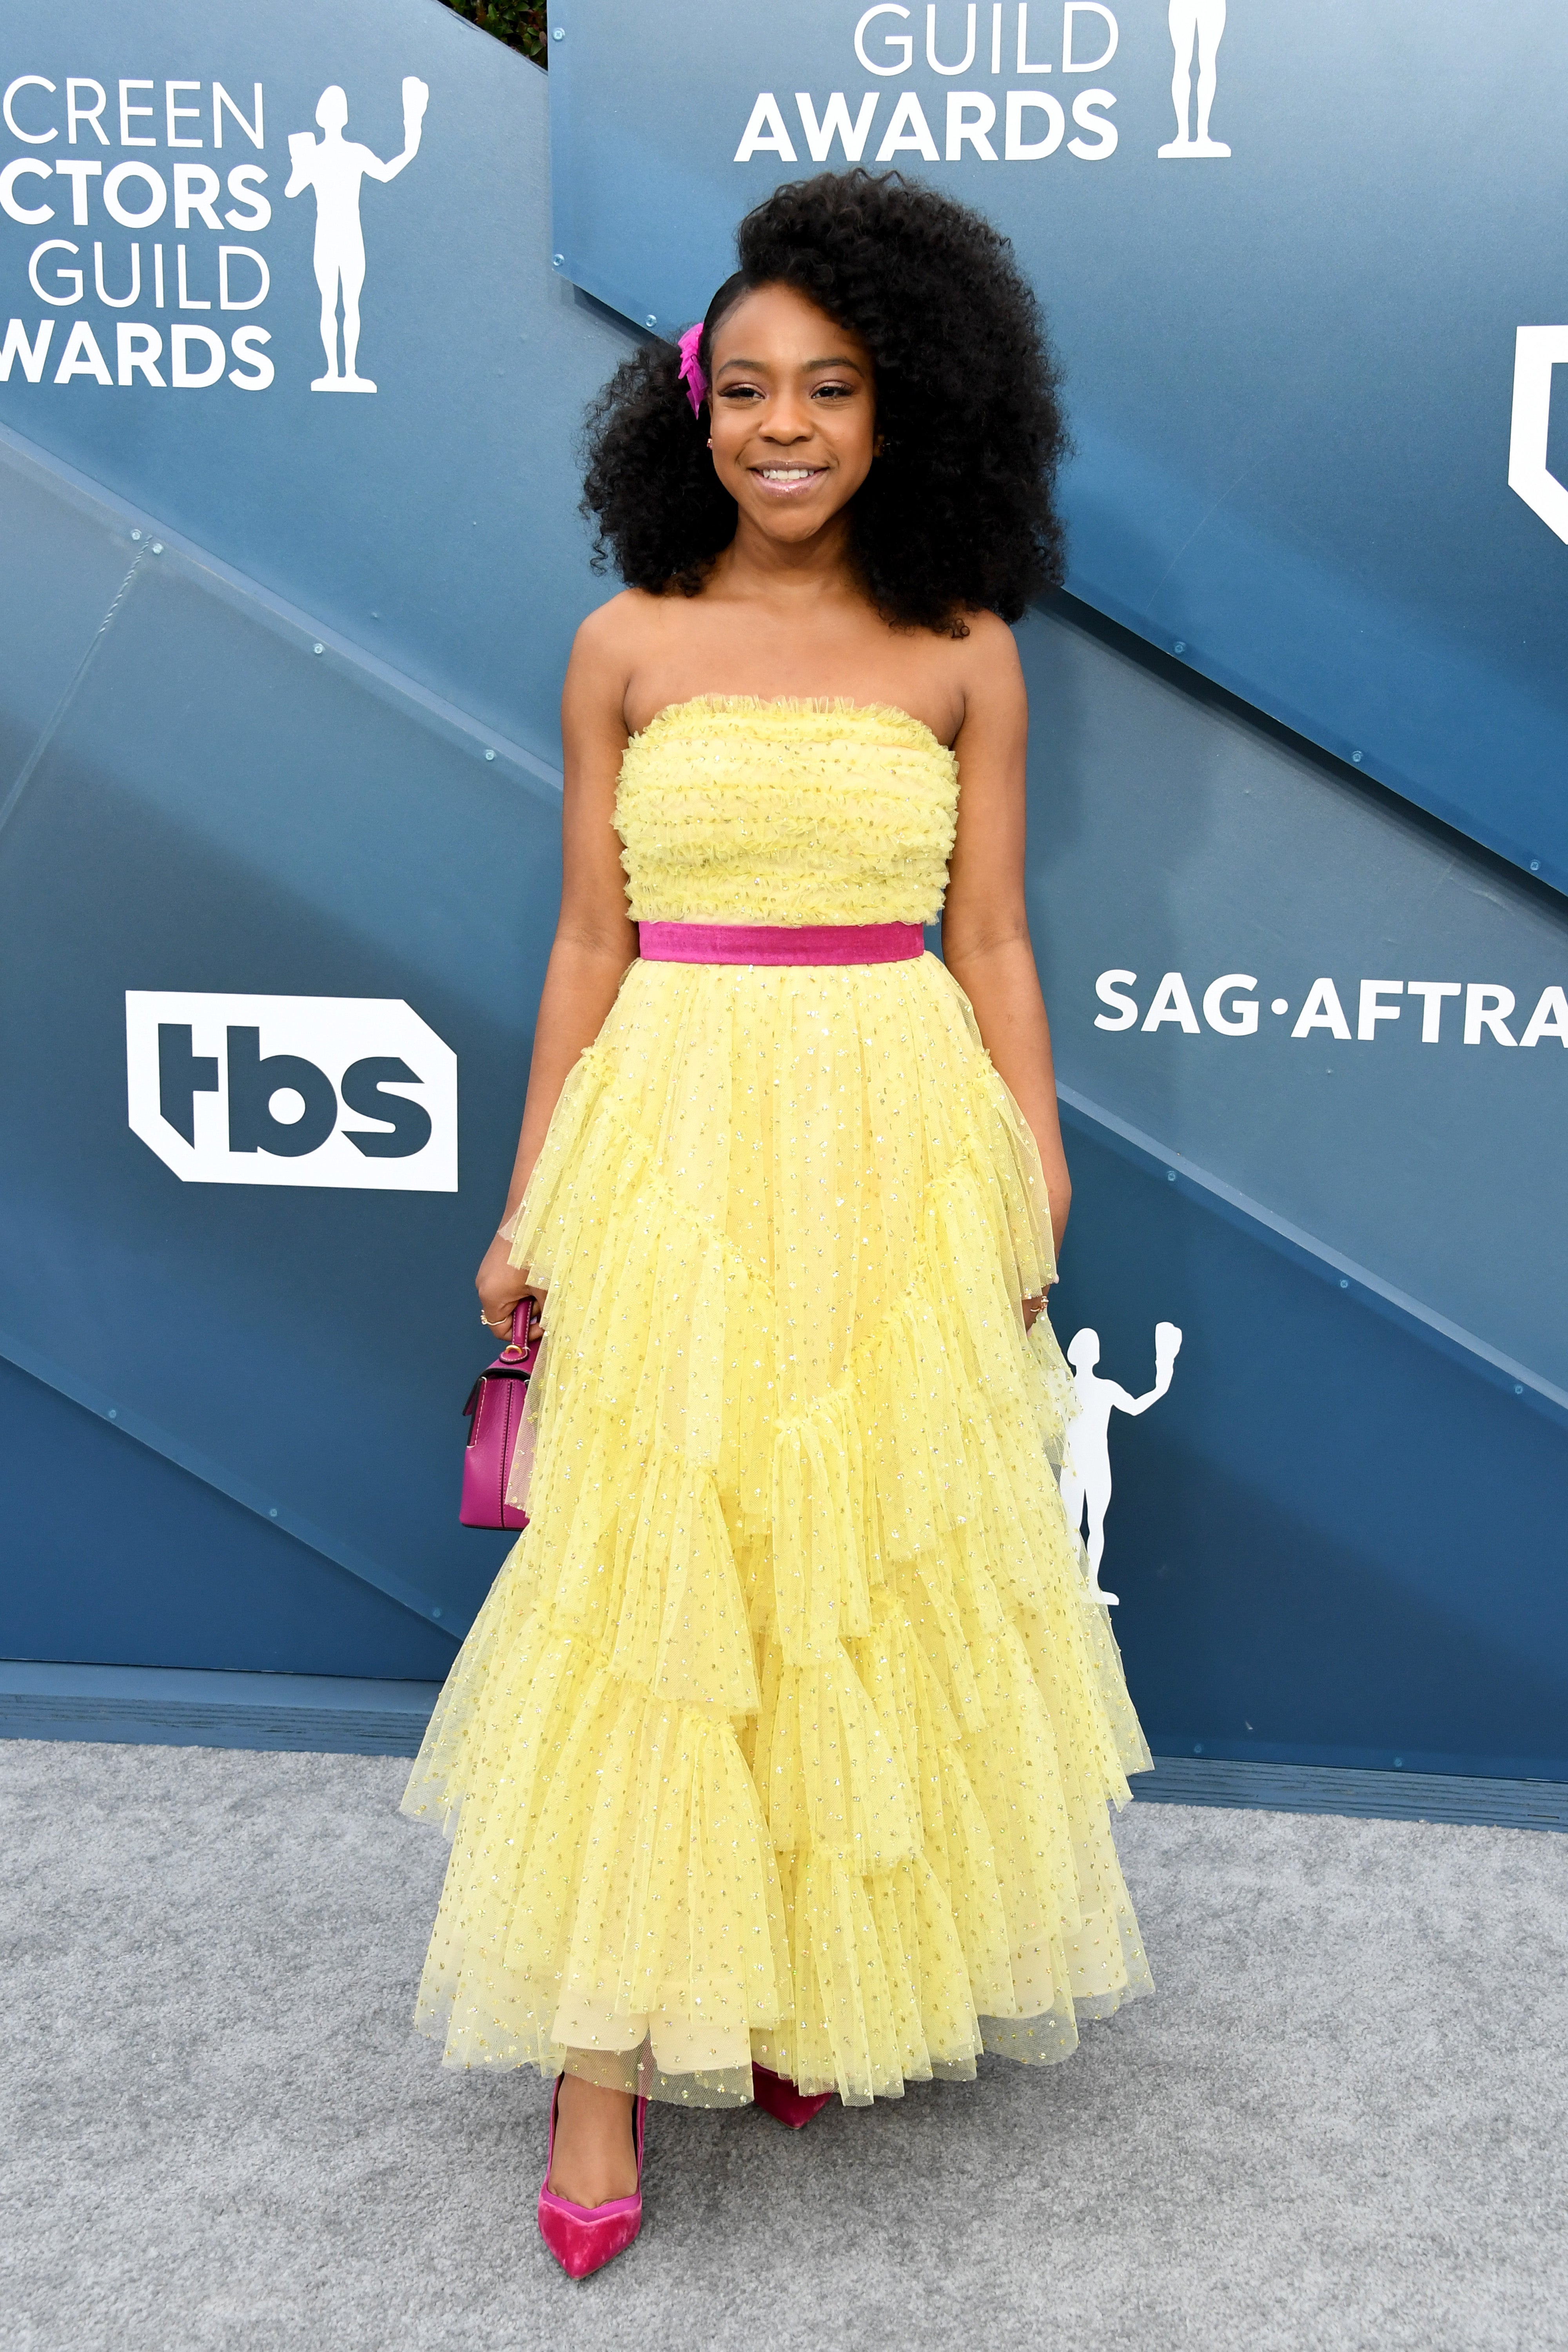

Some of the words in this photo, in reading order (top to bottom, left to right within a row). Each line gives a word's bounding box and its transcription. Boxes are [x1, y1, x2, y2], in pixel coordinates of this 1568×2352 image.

[854, 1, 1119, 76] GUILD
[3, 75, 264, 149] CREEN
[733, 88, 1118, 162] AWARDS
[0, 158, 272, 232] CTORS
[28, 239, 270, 310] GUILD
[158, 1023, 432, 1158] tbs
